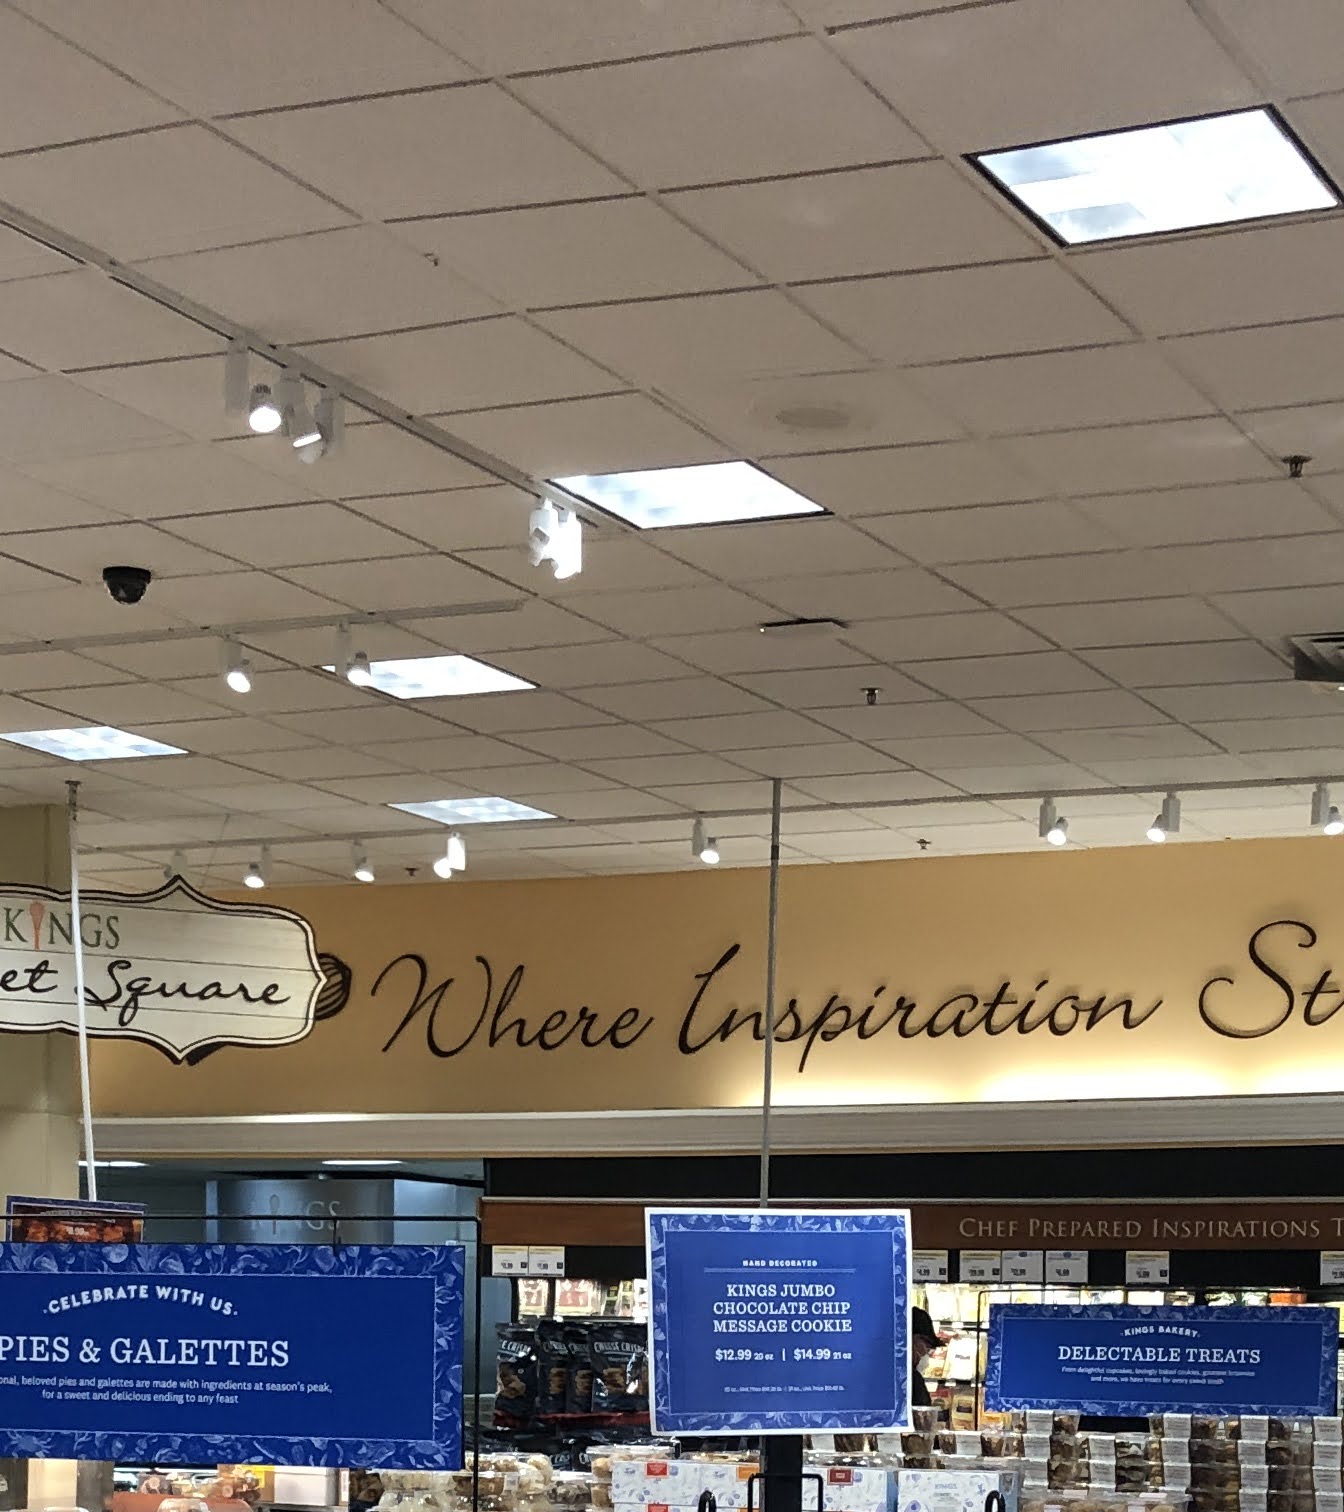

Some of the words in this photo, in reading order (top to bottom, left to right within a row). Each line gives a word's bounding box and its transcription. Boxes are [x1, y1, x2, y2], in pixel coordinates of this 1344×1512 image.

[2, 900, 120, 951] KINGS
[78, 961, 291, 1027] Square
[370, 953, 654, 1059] Where
[677, 943, 1162, 1074] Inspiration
[959, 1217, 1018, 1238] CHEF
[1029, 1217, 1142, 1238] PREPARED
[1153, 1217, 1320, 1239] INSPIRATIONS
[47, 1284, 150, 1314] CELEBRATE
[155, 1285, 204, 1306] WITH
[727, 1284, 777, 1297] KINGS
[780, 1284, 835, 1297] JUMBO
[713, 1302, 808, 1315] CHOCOLATE
[812, 1302, 851, 1315] CHIP
[713, 1320, 788, 1333] MESSAGE
[791, 1319, 853, 1333] COOKIE
[1124, 1326, 1154, 1336] KINGS
[1158, 1326, 1198, 1337] BAKERY
[79, 1338, 101, 1363] &
[110, 1337, 290, 1367] GALETTES
[715, 1348, 752, 1361] $12.99
[794, 1348, 831, 1361] $14.99
[843, 1352, 852, 1360] oz
[1058, 1346, 1181, 1362] DELECTABLE
[1186, 1348, 1261, 1364] TREATS
[21, 1376, 56, 1387] beloved
[58, 1377, 77, 1389] pies
[79, 1378, 96, 1388] and
[98, 1378, 134, 1390] galettes
[135, 1380, 150, 1389] are
[153, 1379, 178, 1390] made
[179, 1379, 199, 1390] with
[201, 1380, 252, 1392] ingredients
[254, 1382, 264, 1391] at
[265, 1381, 305, 1392] season's
[42, 1389, 55, 1399] for
[64, 1391, 90, 1400] sweet
[92, 1390, 109, 1401] and
[111, 1390, 152, 1402] delicious
[153, 1392, 184, 1404] ending
[186, 1393, 196, 1403] to
[197, 1394, 213, 1405] any
[216, 1393, 239, 1404] feast
